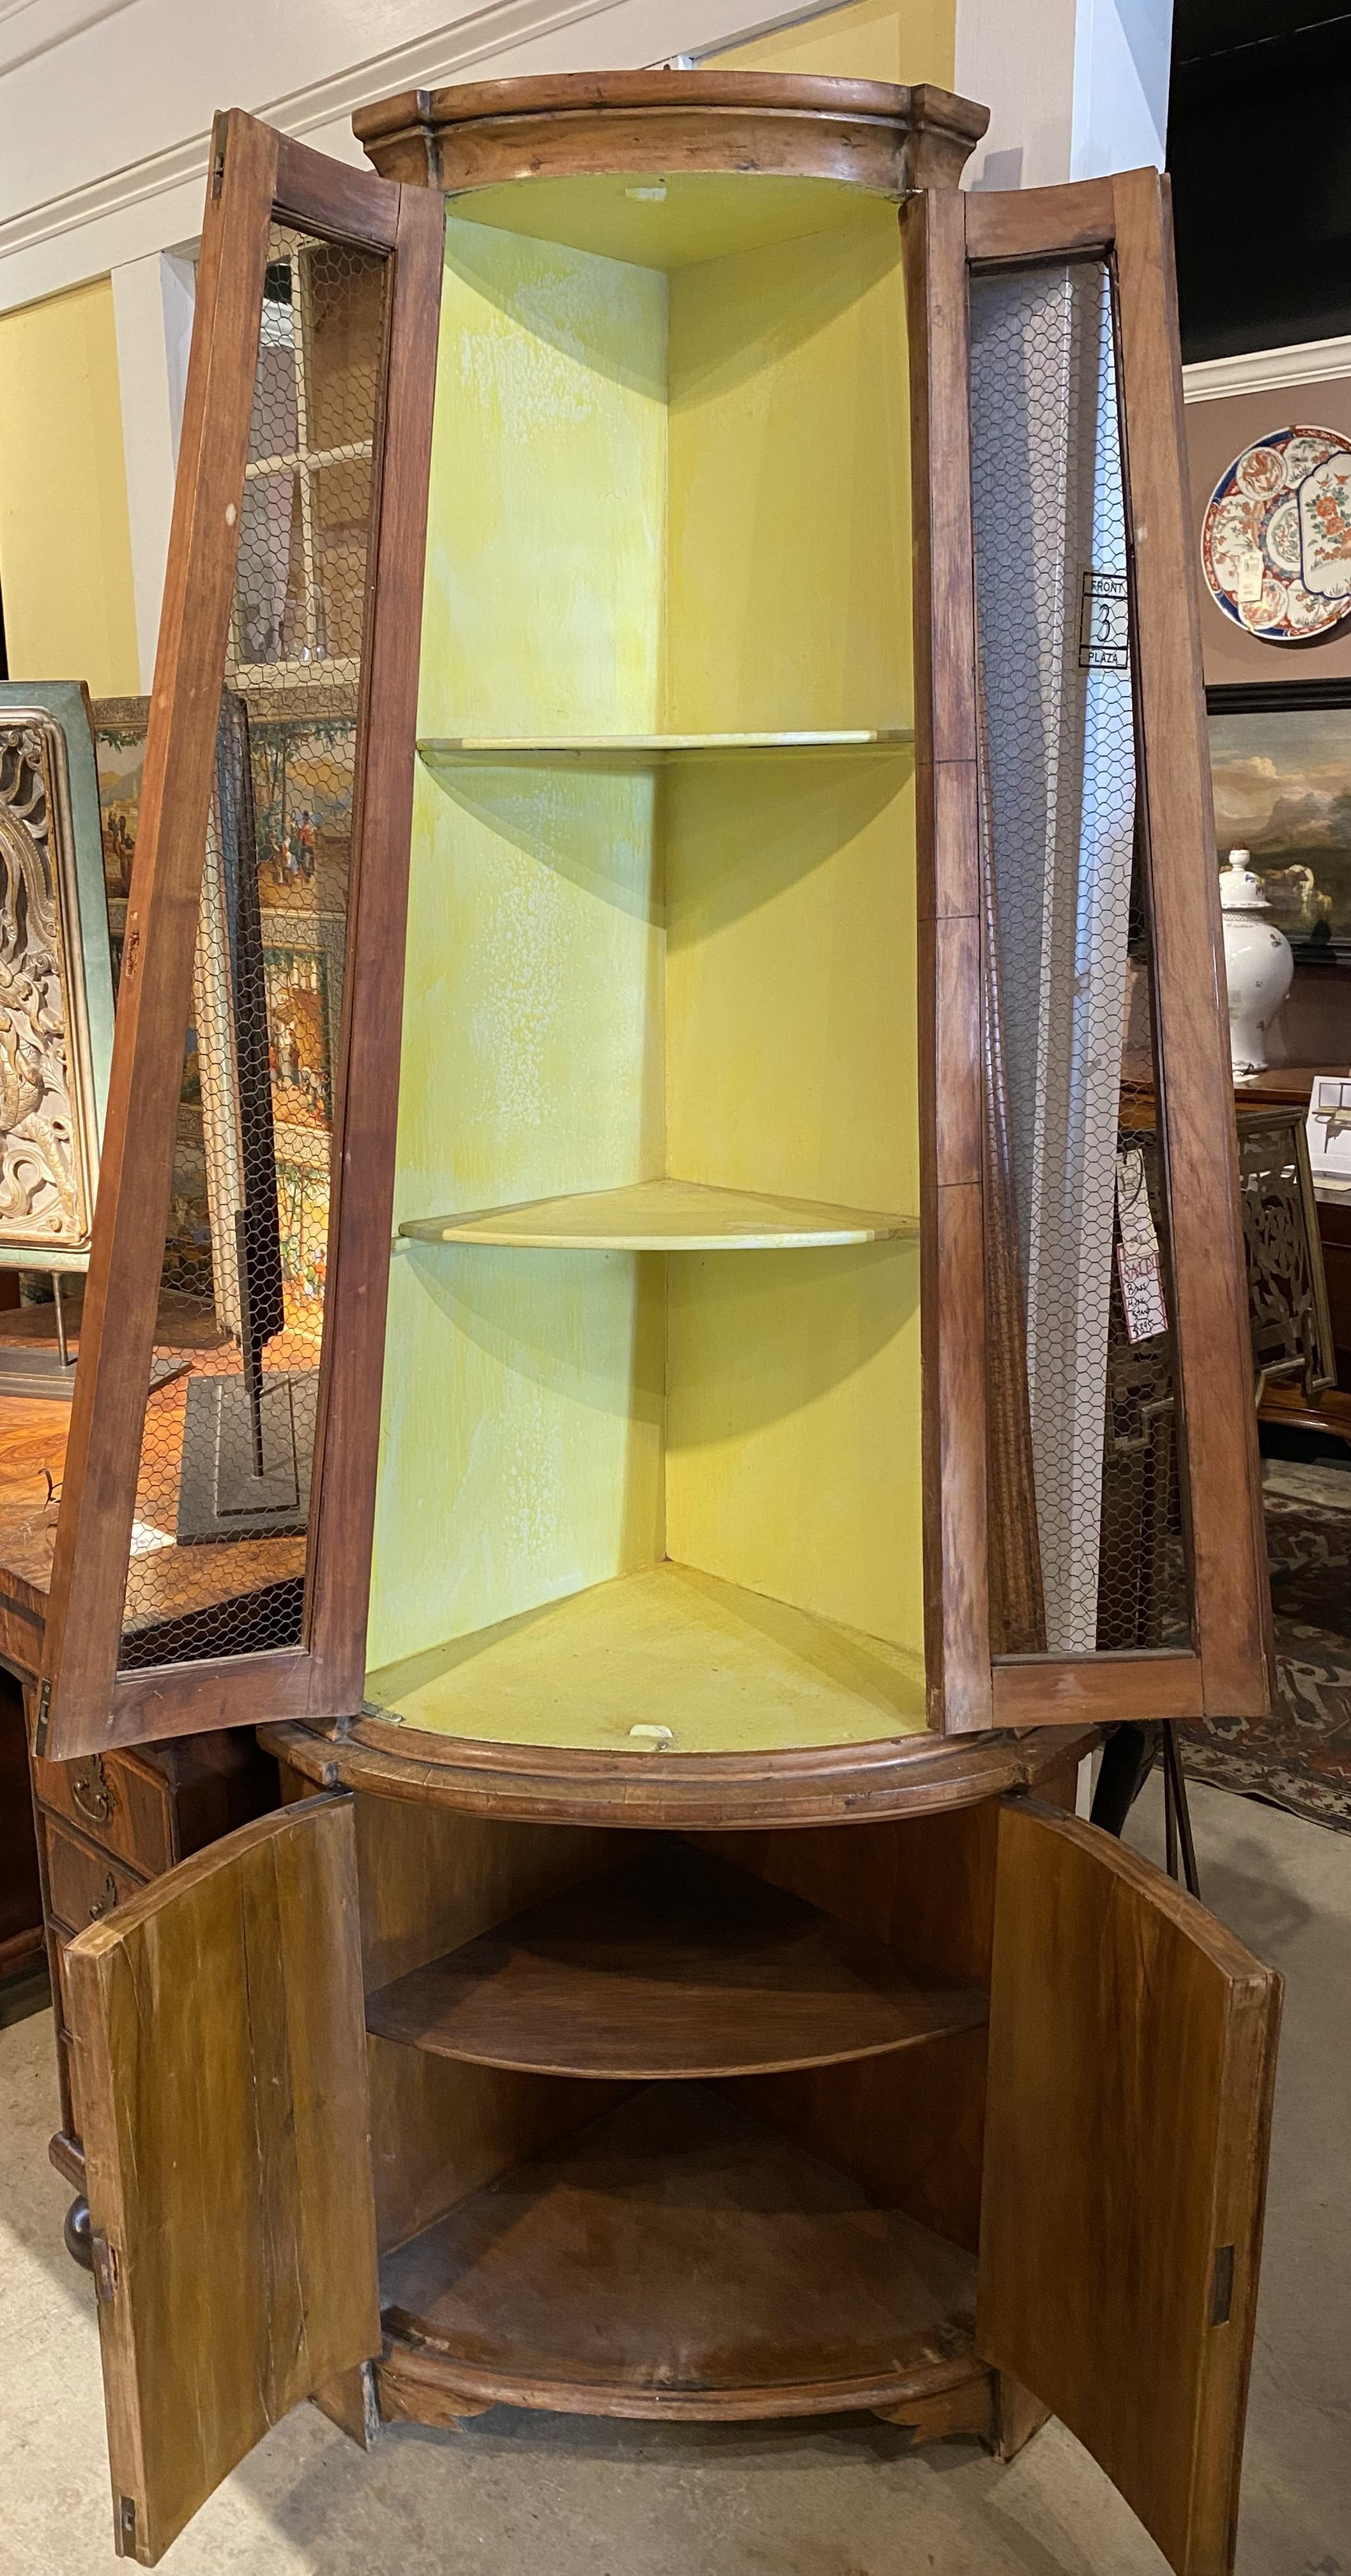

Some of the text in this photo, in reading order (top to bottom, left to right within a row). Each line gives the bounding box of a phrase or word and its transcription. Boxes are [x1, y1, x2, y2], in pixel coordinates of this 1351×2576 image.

[1091, 581, 1122, 594] FRONT
[1097, 604, 1110, 641] 3
[1088, 652, 1118, 663] PLAZA
